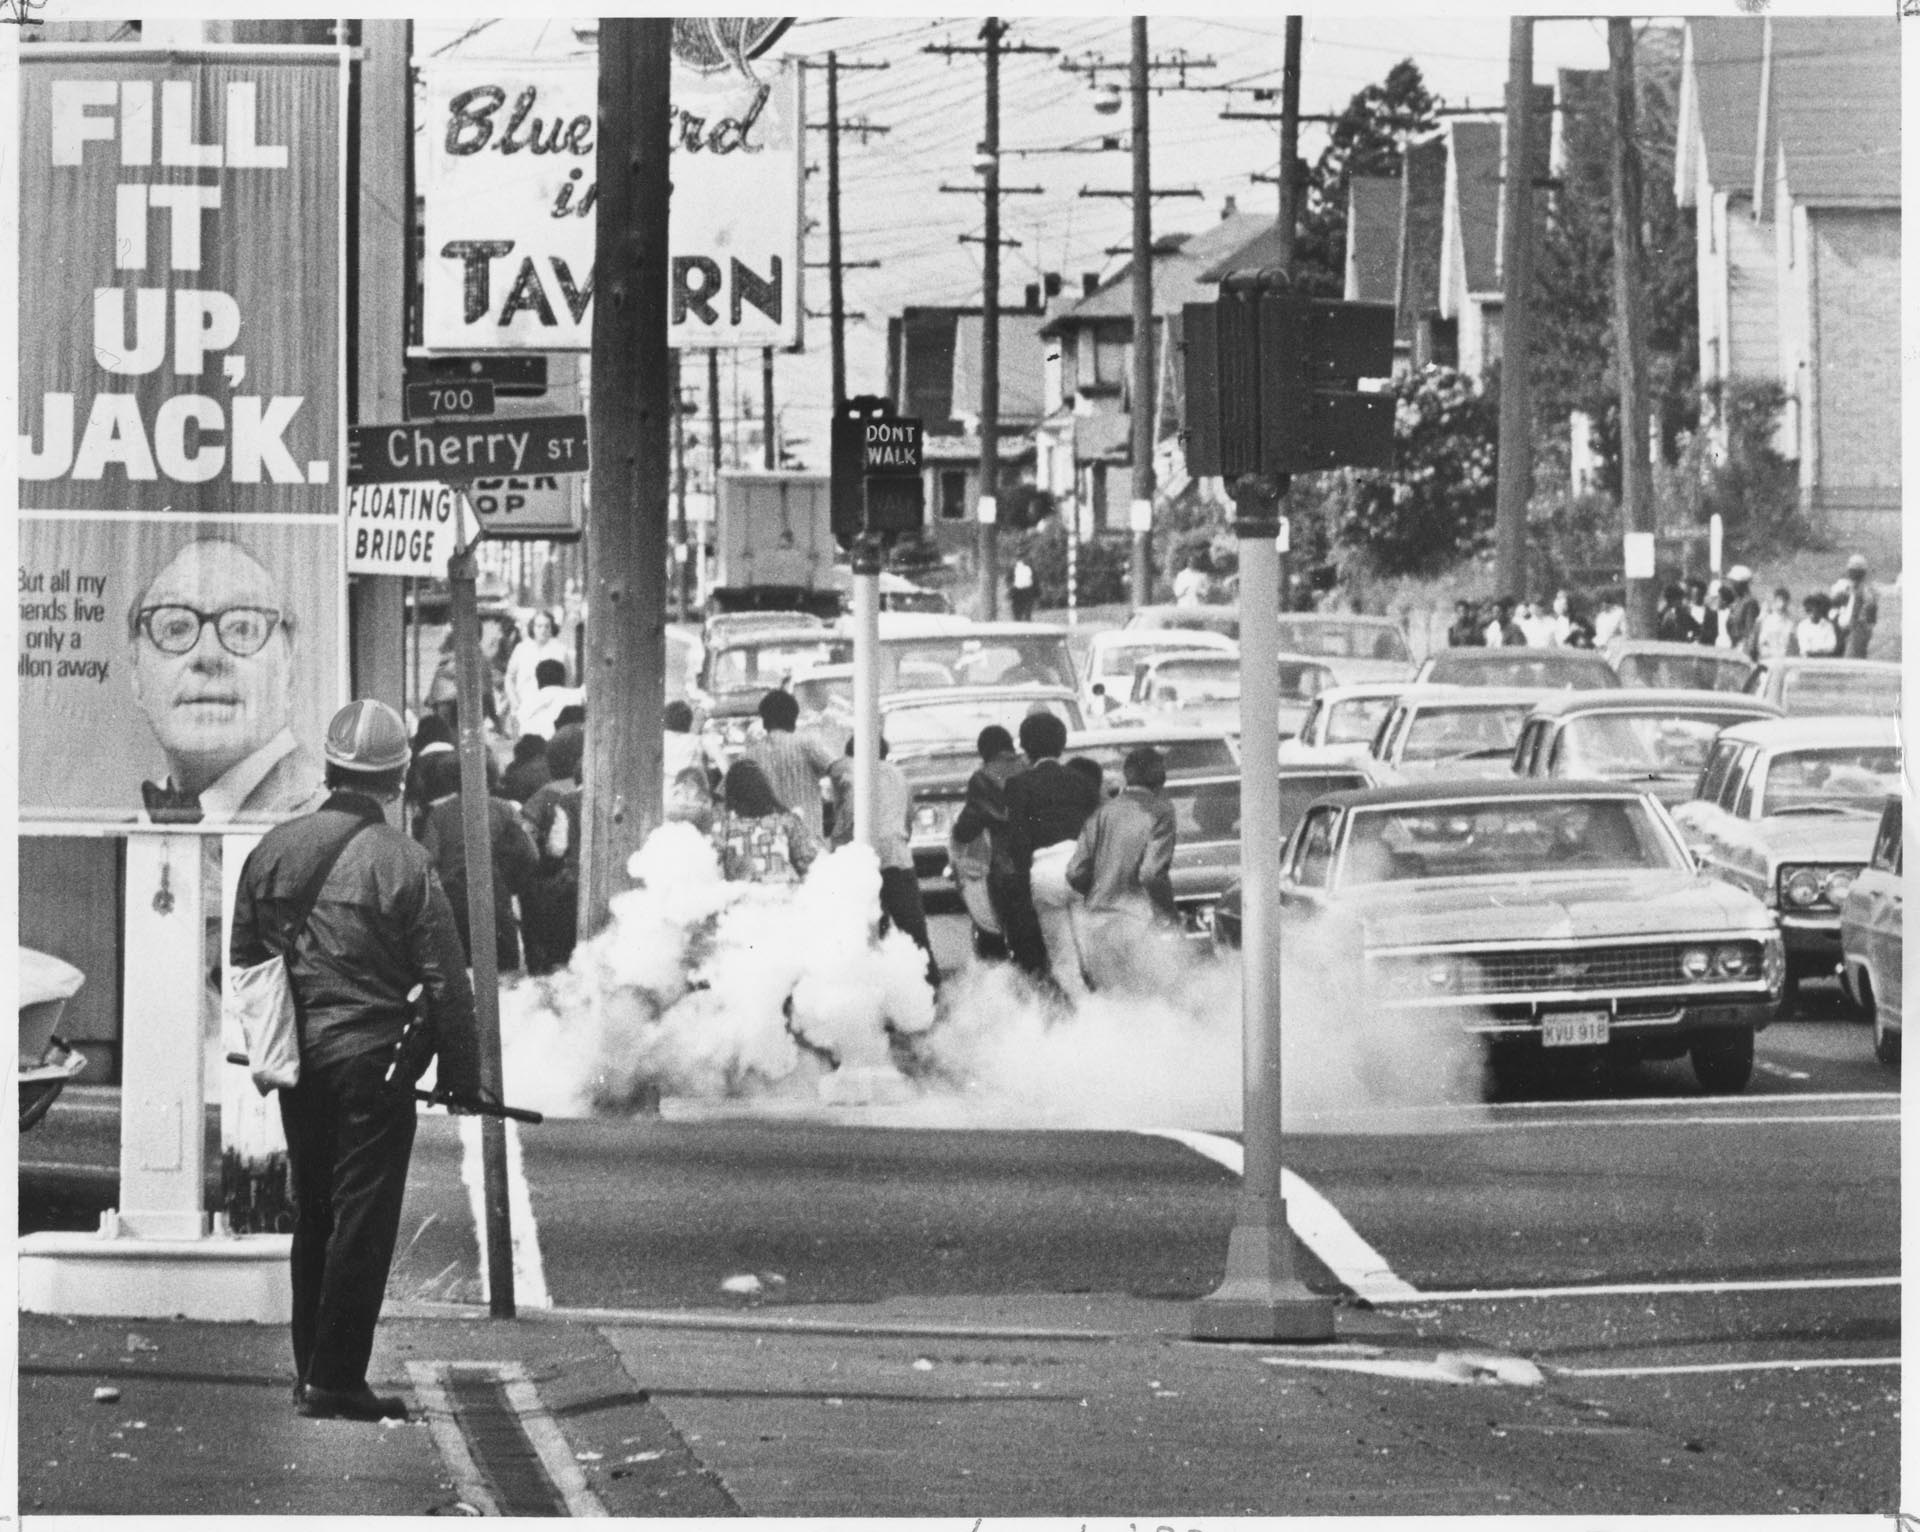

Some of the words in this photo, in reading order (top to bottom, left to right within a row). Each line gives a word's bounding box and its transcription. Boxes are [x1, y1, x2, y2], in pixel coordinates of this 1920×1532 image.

[52, 80, 289, 168] FILL
[445, 84, 771, 155] Bluerd
[116, 184, 222, 271] IT
[440, 239, 783, 327] TAVRN
[94, 287, 246, 388] UP,
[429, 389, 474, 410] 700
[19, 392, 330, 484] JACK.
[387, 428, 530, 471] Cherry
[547, 438, 575, 460] ST
[866, 423, 916, 443] DONT
[867, 445, 917, 466] WALK
[348, 485, 452, 523] FLOATING
[355, 528, 435, 562] BRIDGE
[50, 568, 71, 594] all
[77, 574, 107, 599] my
[74, 597, 105, 622] live
[26, 624, 65, 653] only
[70, 631, 82, 650] a
[18, 653, 53, 678] llon
